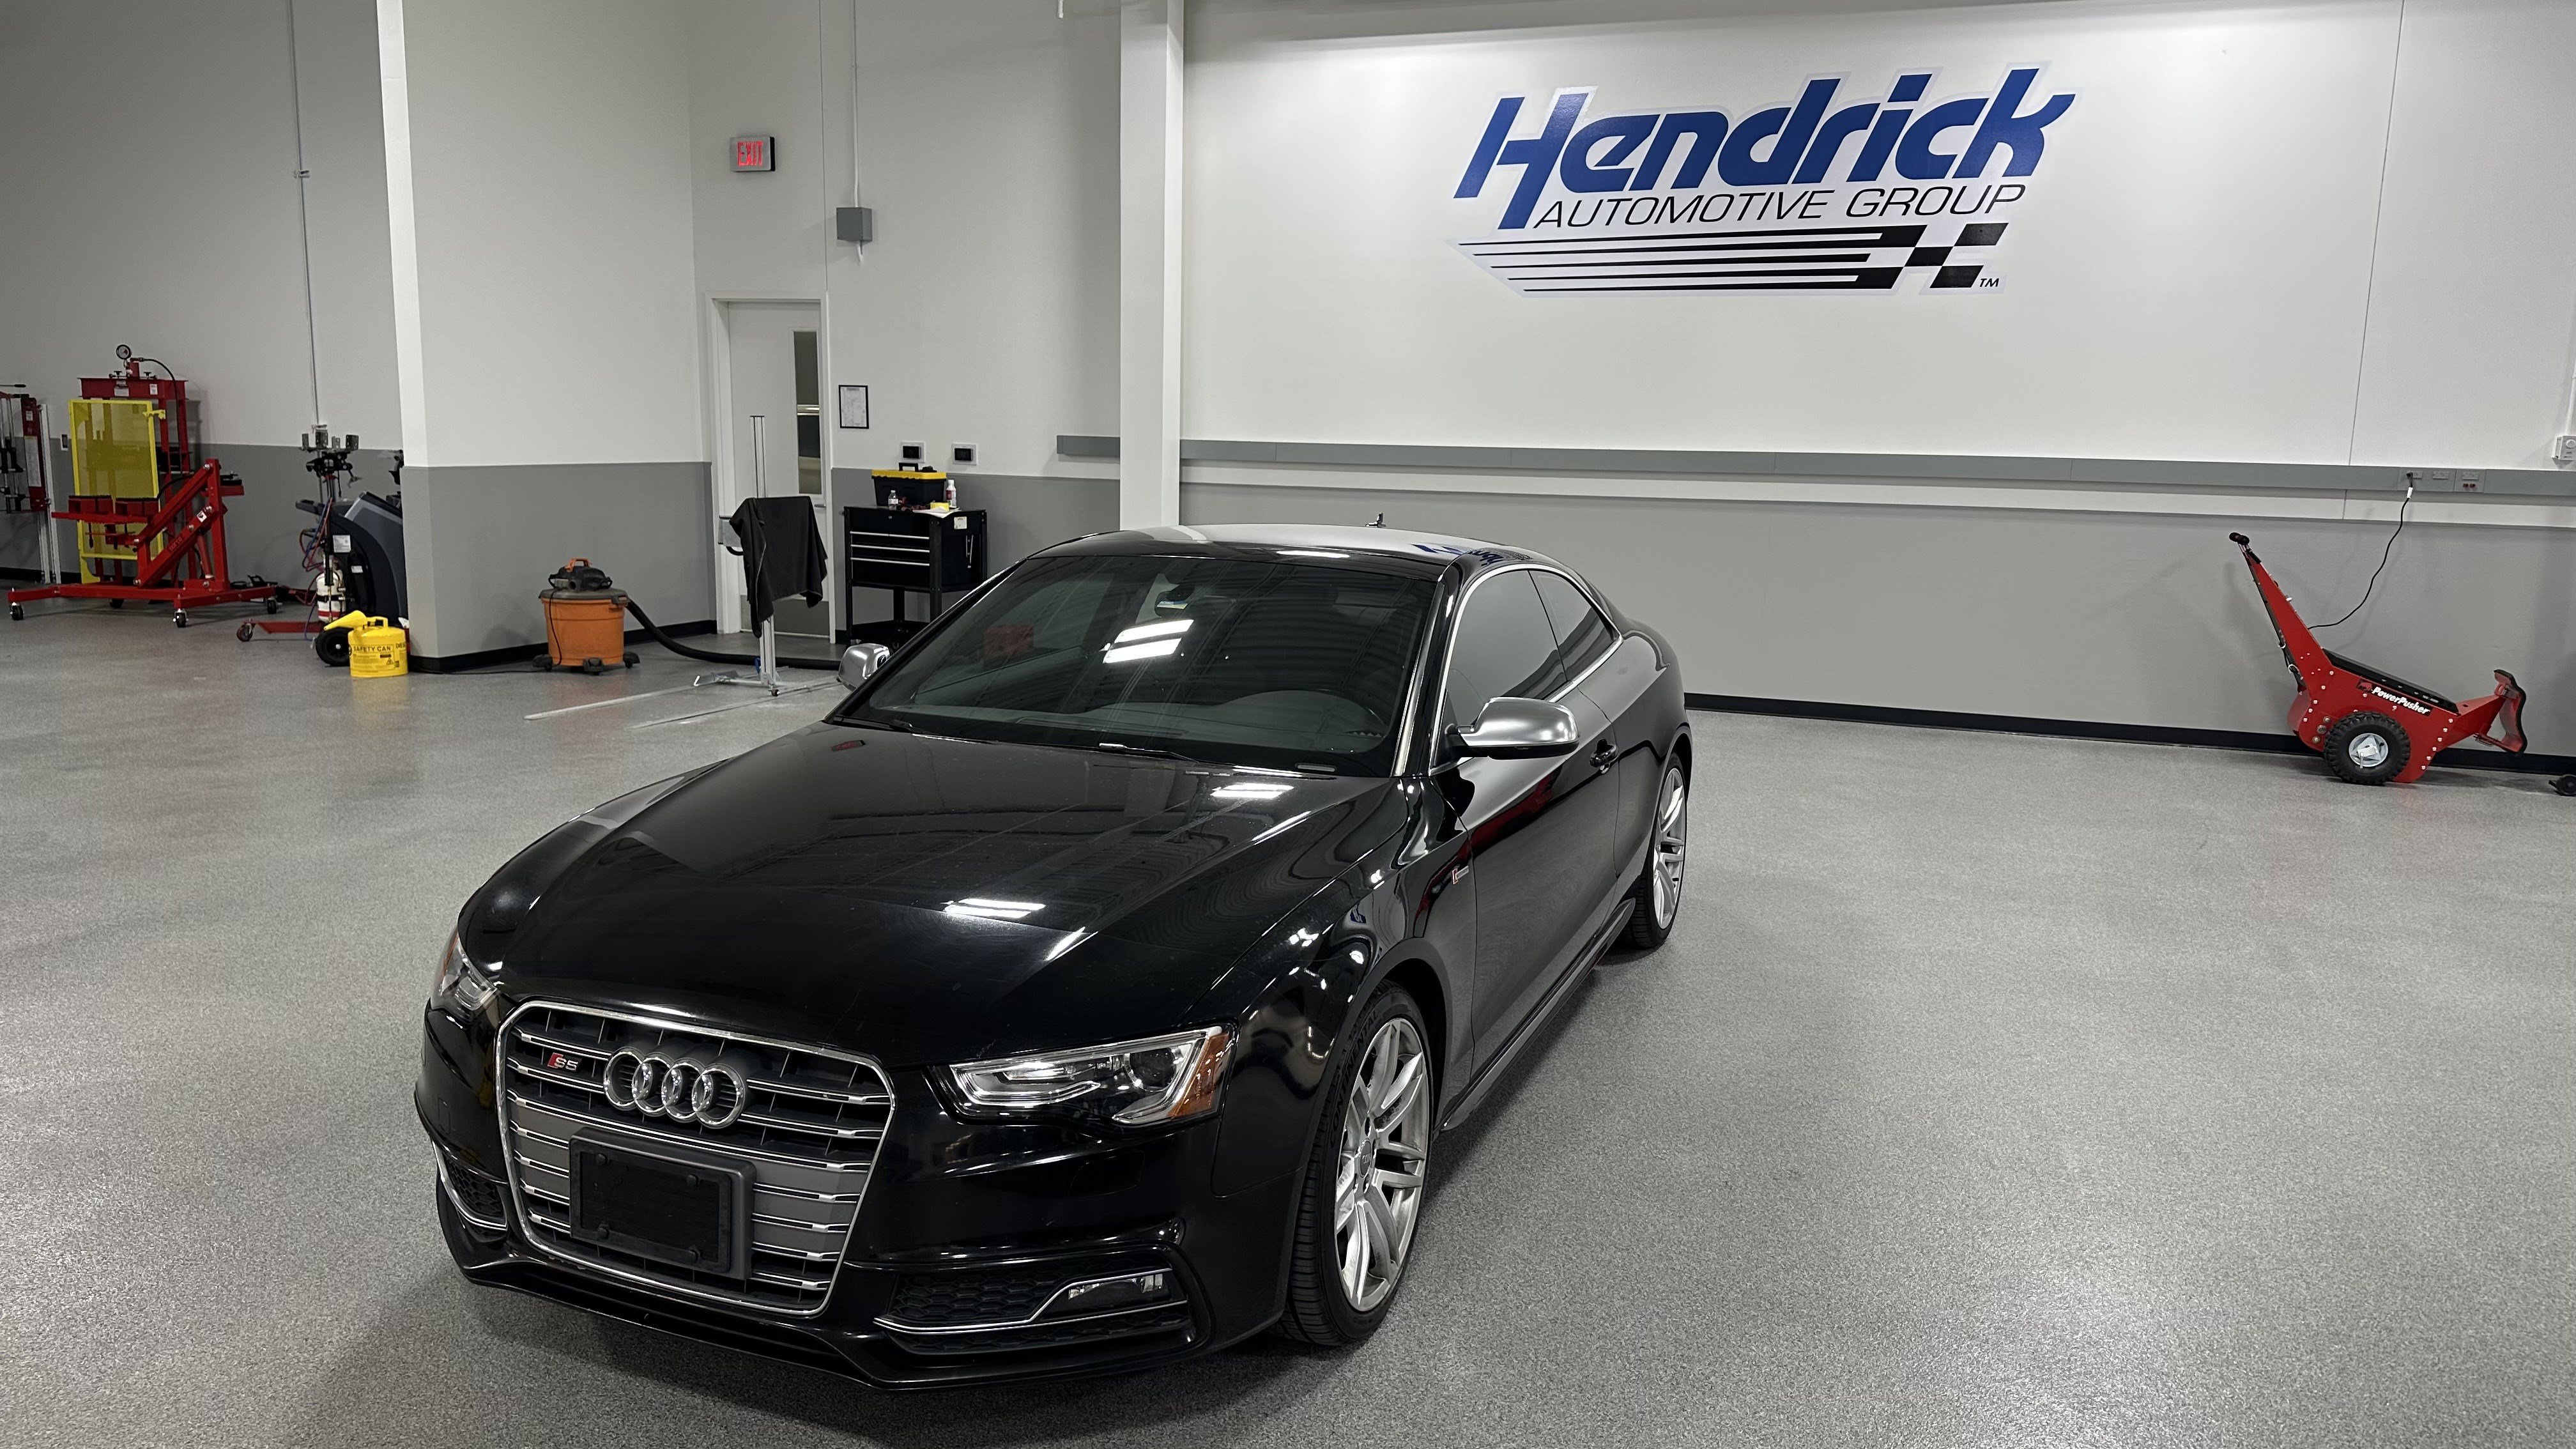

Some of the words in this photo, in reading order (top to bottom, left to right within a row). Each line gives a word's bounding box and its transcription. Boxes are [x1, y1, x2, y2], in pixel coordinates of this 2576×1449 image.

[737, 141, 763, 166] EXIT
[1454, 68, 2075, 230] Hendrick
[1533, 189, 1836, 229] AUTOMOTIVE
[1846, 184, 2026, 219] GROUP
[1979, 277, 2000, 288] TM
[2372, 687, 2428, 714] PowerPusher
[554, 1057, 578, 1071] S5
[1330, 1011, 1379, 1148] CONTINENTAL
